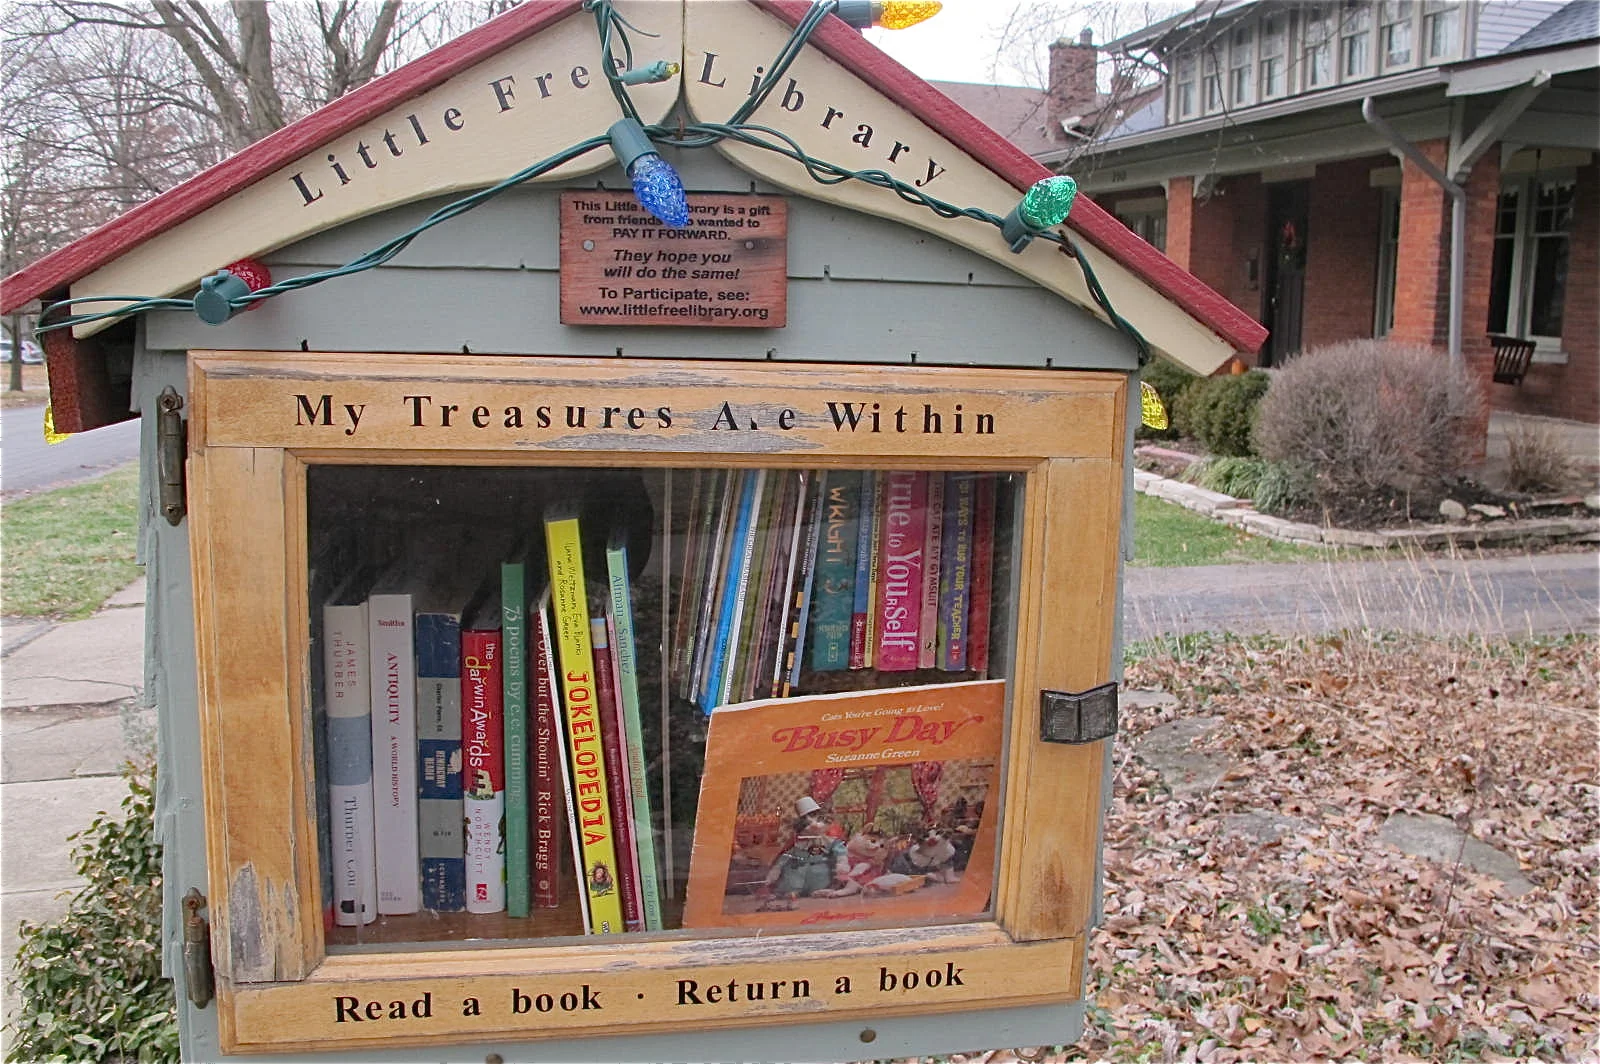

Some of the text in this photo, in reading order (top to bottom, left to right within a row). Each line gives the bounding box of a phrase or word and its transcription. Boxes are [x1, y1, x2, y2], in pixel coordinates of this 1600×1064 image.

[697, 51, 947, 188] Library
[289, 105, 465, 207] Little
[573, 200, 601, 212] This
[605, 201, 638, 212] Little
[686, 203, 719, 216] brary
[723, 205, 735, 215] is
[738, 207, 746, 215] a
[749, 205, 771, 217] gift
[583, 214, 614, 225] from
[617, 214, 663, 226] friends
[697, 217, 744, 228] wanted
[747, 218, 761, 229] to
[612, 228, 732, 241] PAY IT FORWARD.
[604, 266, 742, 281] will do the same!
[614, 249, 732, 266] They hope you
[579, 304, 769, 320] www.littlefreelibrary.org
[598, 287, 750, 303] To Participate, see:
[293, 394, 367, 436] My
[403, 395, 672, 430] Treasures
[826, 401, 995, 434] Within
[888, 533, 904, 549] to
[556, 560, 565, 576] and
[928, 563, 939, 607] GYMSUIT
[503, 605, 522, 622] 75
[612, 576, 624, 618] Altman
[619, 628, 631, 675] Sanchez
[950, 594, 963, 641] TEACHER
[333, 631, 344, 698] THURBER
[346, 641, 357, 687] JAMES
[485, 643, 496, 660] the
[506, 626, 522, 677] poems
[386, 652, 401, 725] ANTIQUITY
[507, 682, 523, 701] by
[537, 677, 550, 698] but
[538, 703, 550, 724] the
[917, 703, 944, 713] Love!
[772, 715, 984, 753] Busy Day
[508, 735, 522, 809] cummings
[538, 727, 551, 782] Shoutin'
[566, 670, 608, 846] JOKELOPEDIA
[824, 748, 921, 764] Suzanne Green
[391, 773, 400, 808] HISTORY
[474, 808, 483, 874] NORTHCUTT
[483, 823, 492, 860] WENDY
[536, 791, 551, 871] Rick Bragg
[335, 962, 966, 1023] Read a book Return a book
